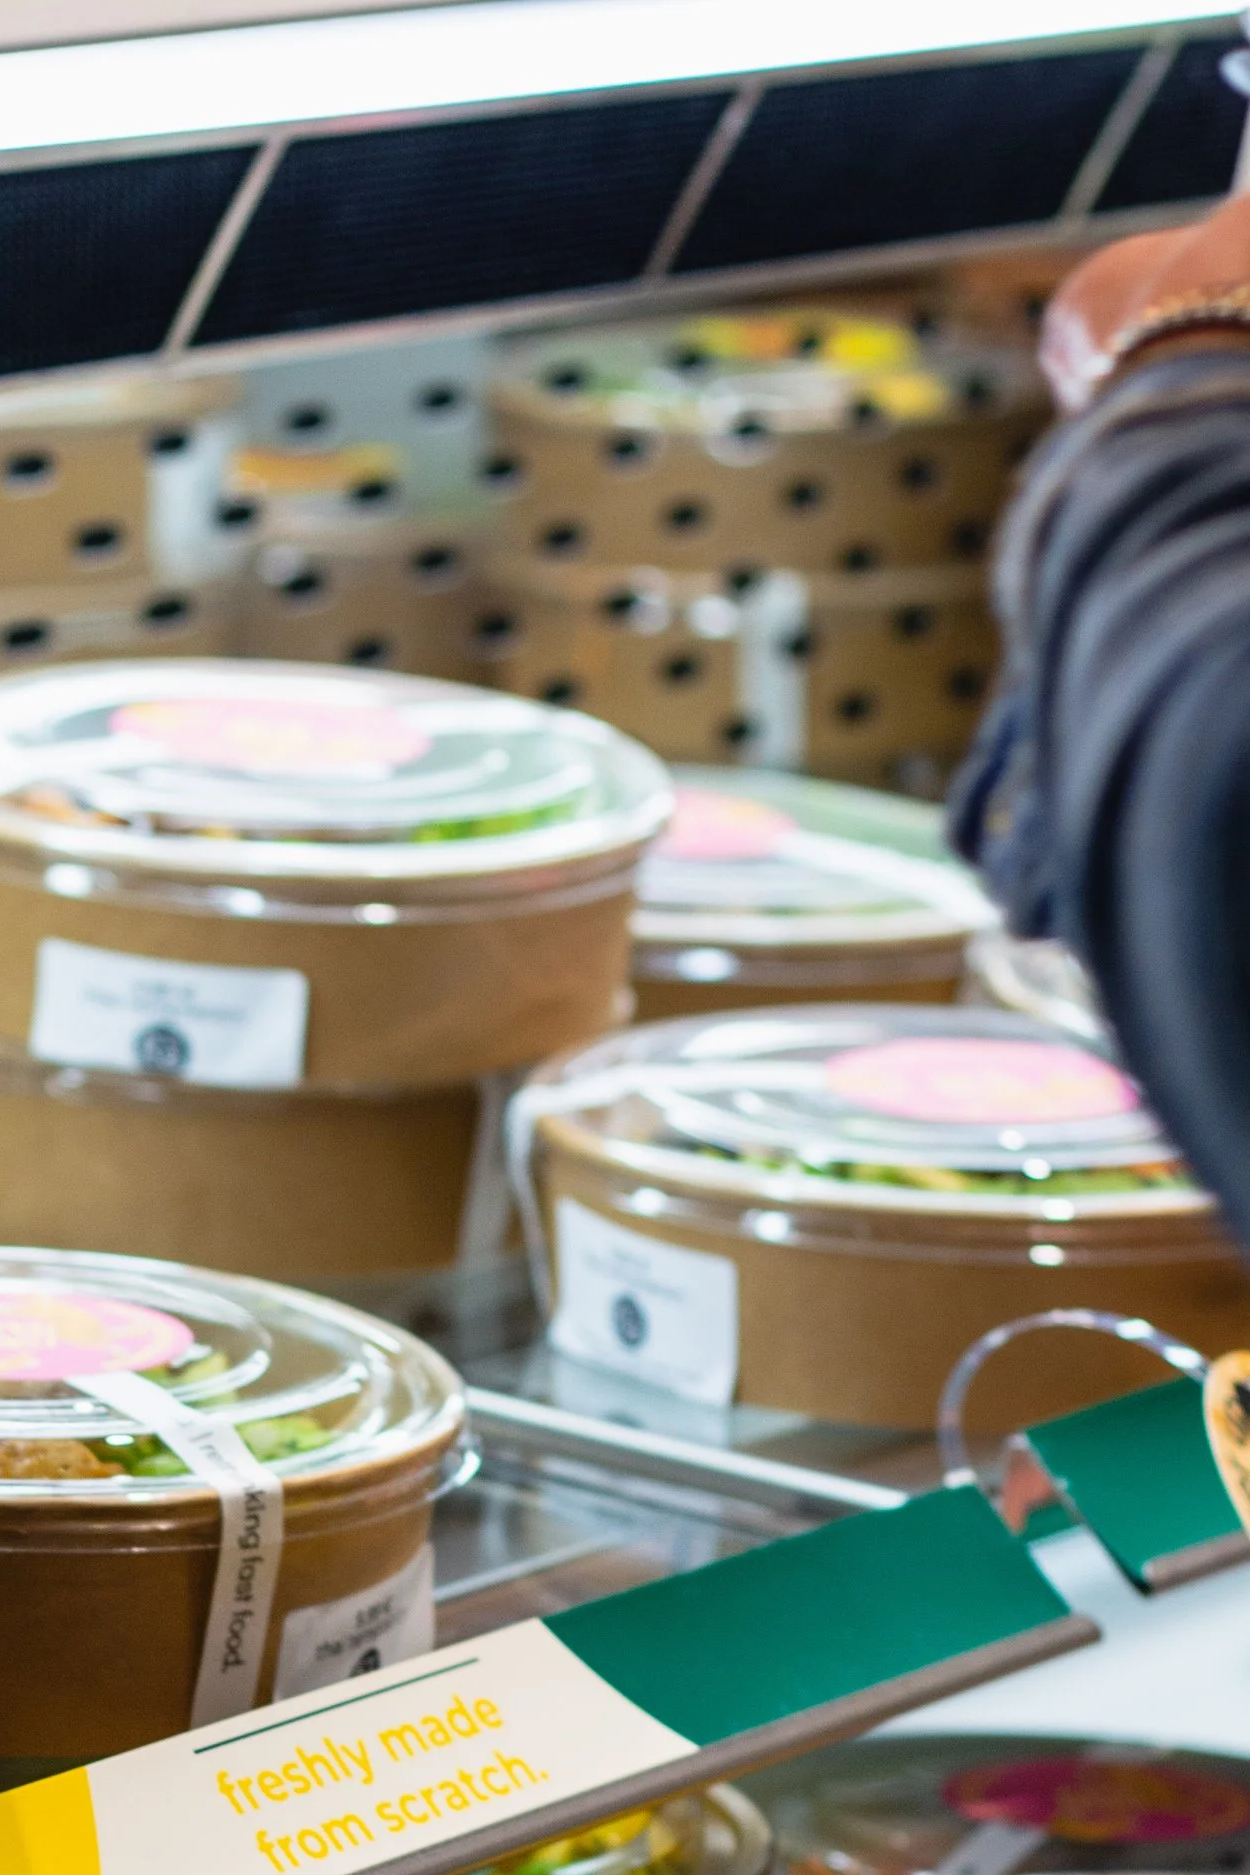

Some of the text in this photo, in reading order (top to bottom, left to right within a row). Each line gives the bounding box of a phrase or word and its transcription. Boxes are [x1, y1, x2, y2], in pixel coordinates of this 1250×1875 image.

[235, 1554, 264, 1603] fast
[220, 1608, 256, 1675] food.
[216, 1693, 505, 1816] freshly made
[255, 1748, 551, 1874] from scratch.
